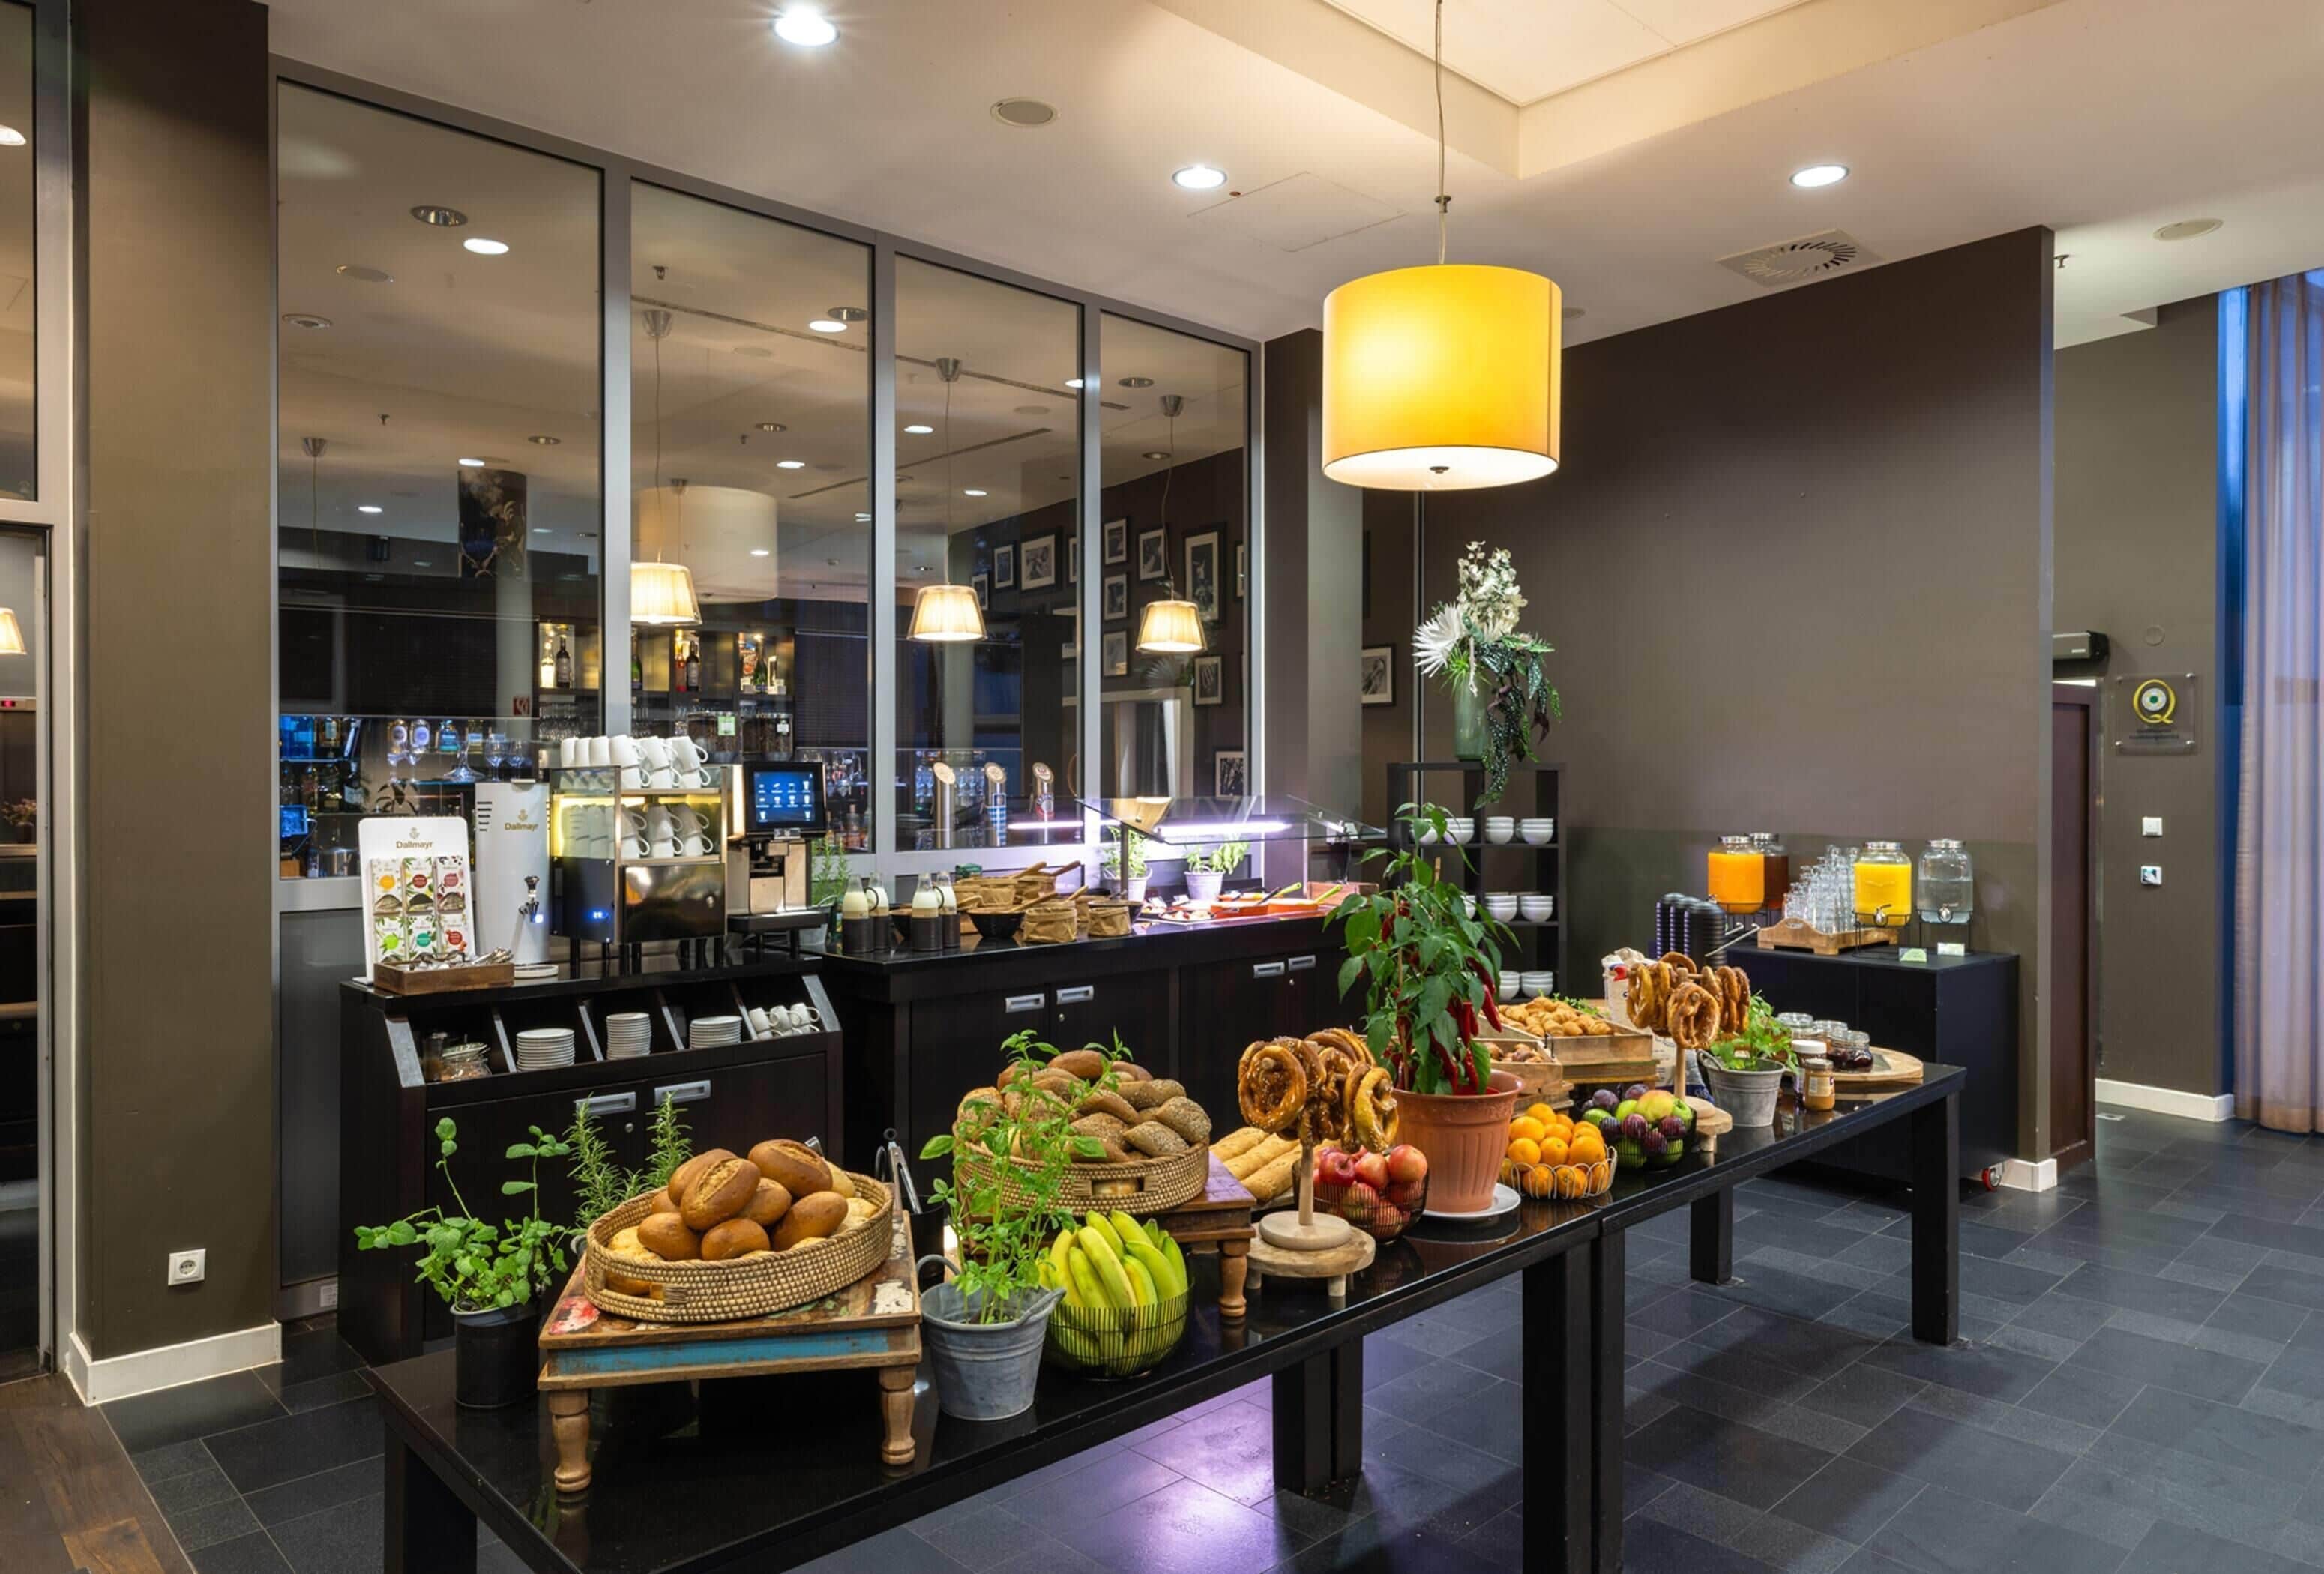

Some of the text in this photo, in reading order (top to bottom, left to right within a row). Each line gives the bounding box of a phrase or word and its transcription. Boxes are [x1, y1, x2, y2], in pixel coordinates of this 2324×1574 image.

[2133, 678, 2176, 724] Q
[505, 822, 538, 832] Dallmayr
[396, 841, 433, 849] Dallmayr
